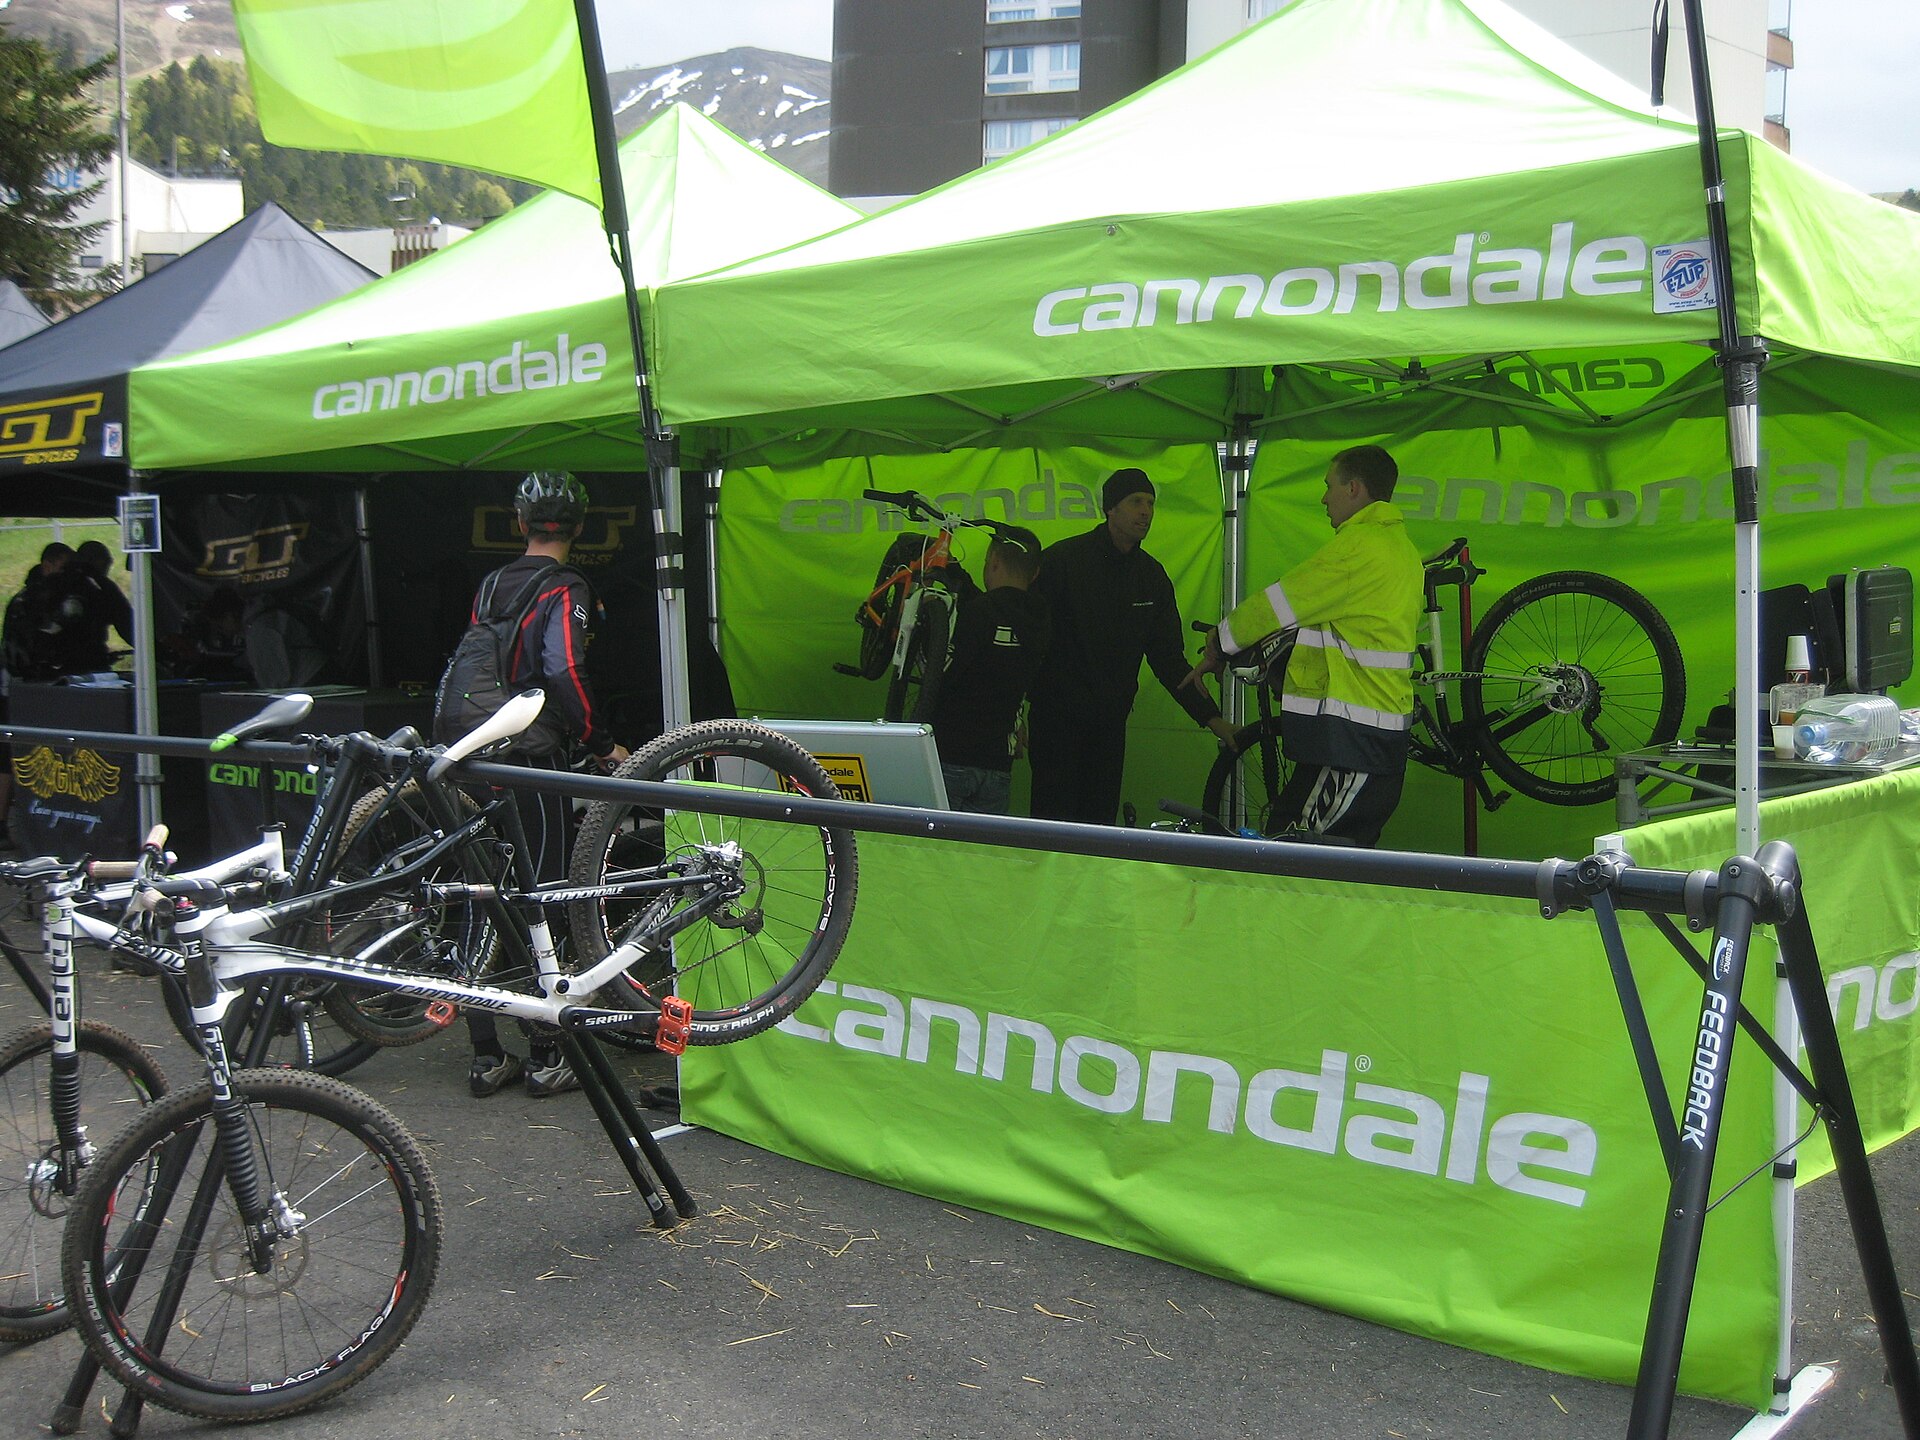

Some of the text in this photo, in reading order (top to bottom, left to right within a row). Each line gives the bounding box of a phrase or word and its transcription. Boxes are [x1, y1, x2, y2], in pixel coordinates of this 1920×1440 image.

[1032, 221, 1646, 338] cannondale
[312, 333, 608, 420] cannondale
[541, 886, 626, 903] CANNONDALE
[820, 864, 836, 932] BLACK
[398, 984, 512, 1012] CANNONDALE
[585, 1014, 633, 1026] SRAM
[731, 1005, 774, 1030] RALPH
[1681, 989, 1728, 1151] FEEDBACK
[82, 1260, 148, 1377] RACING RALPH
[250, 1315, 385, 1393] BLACK FLAG
